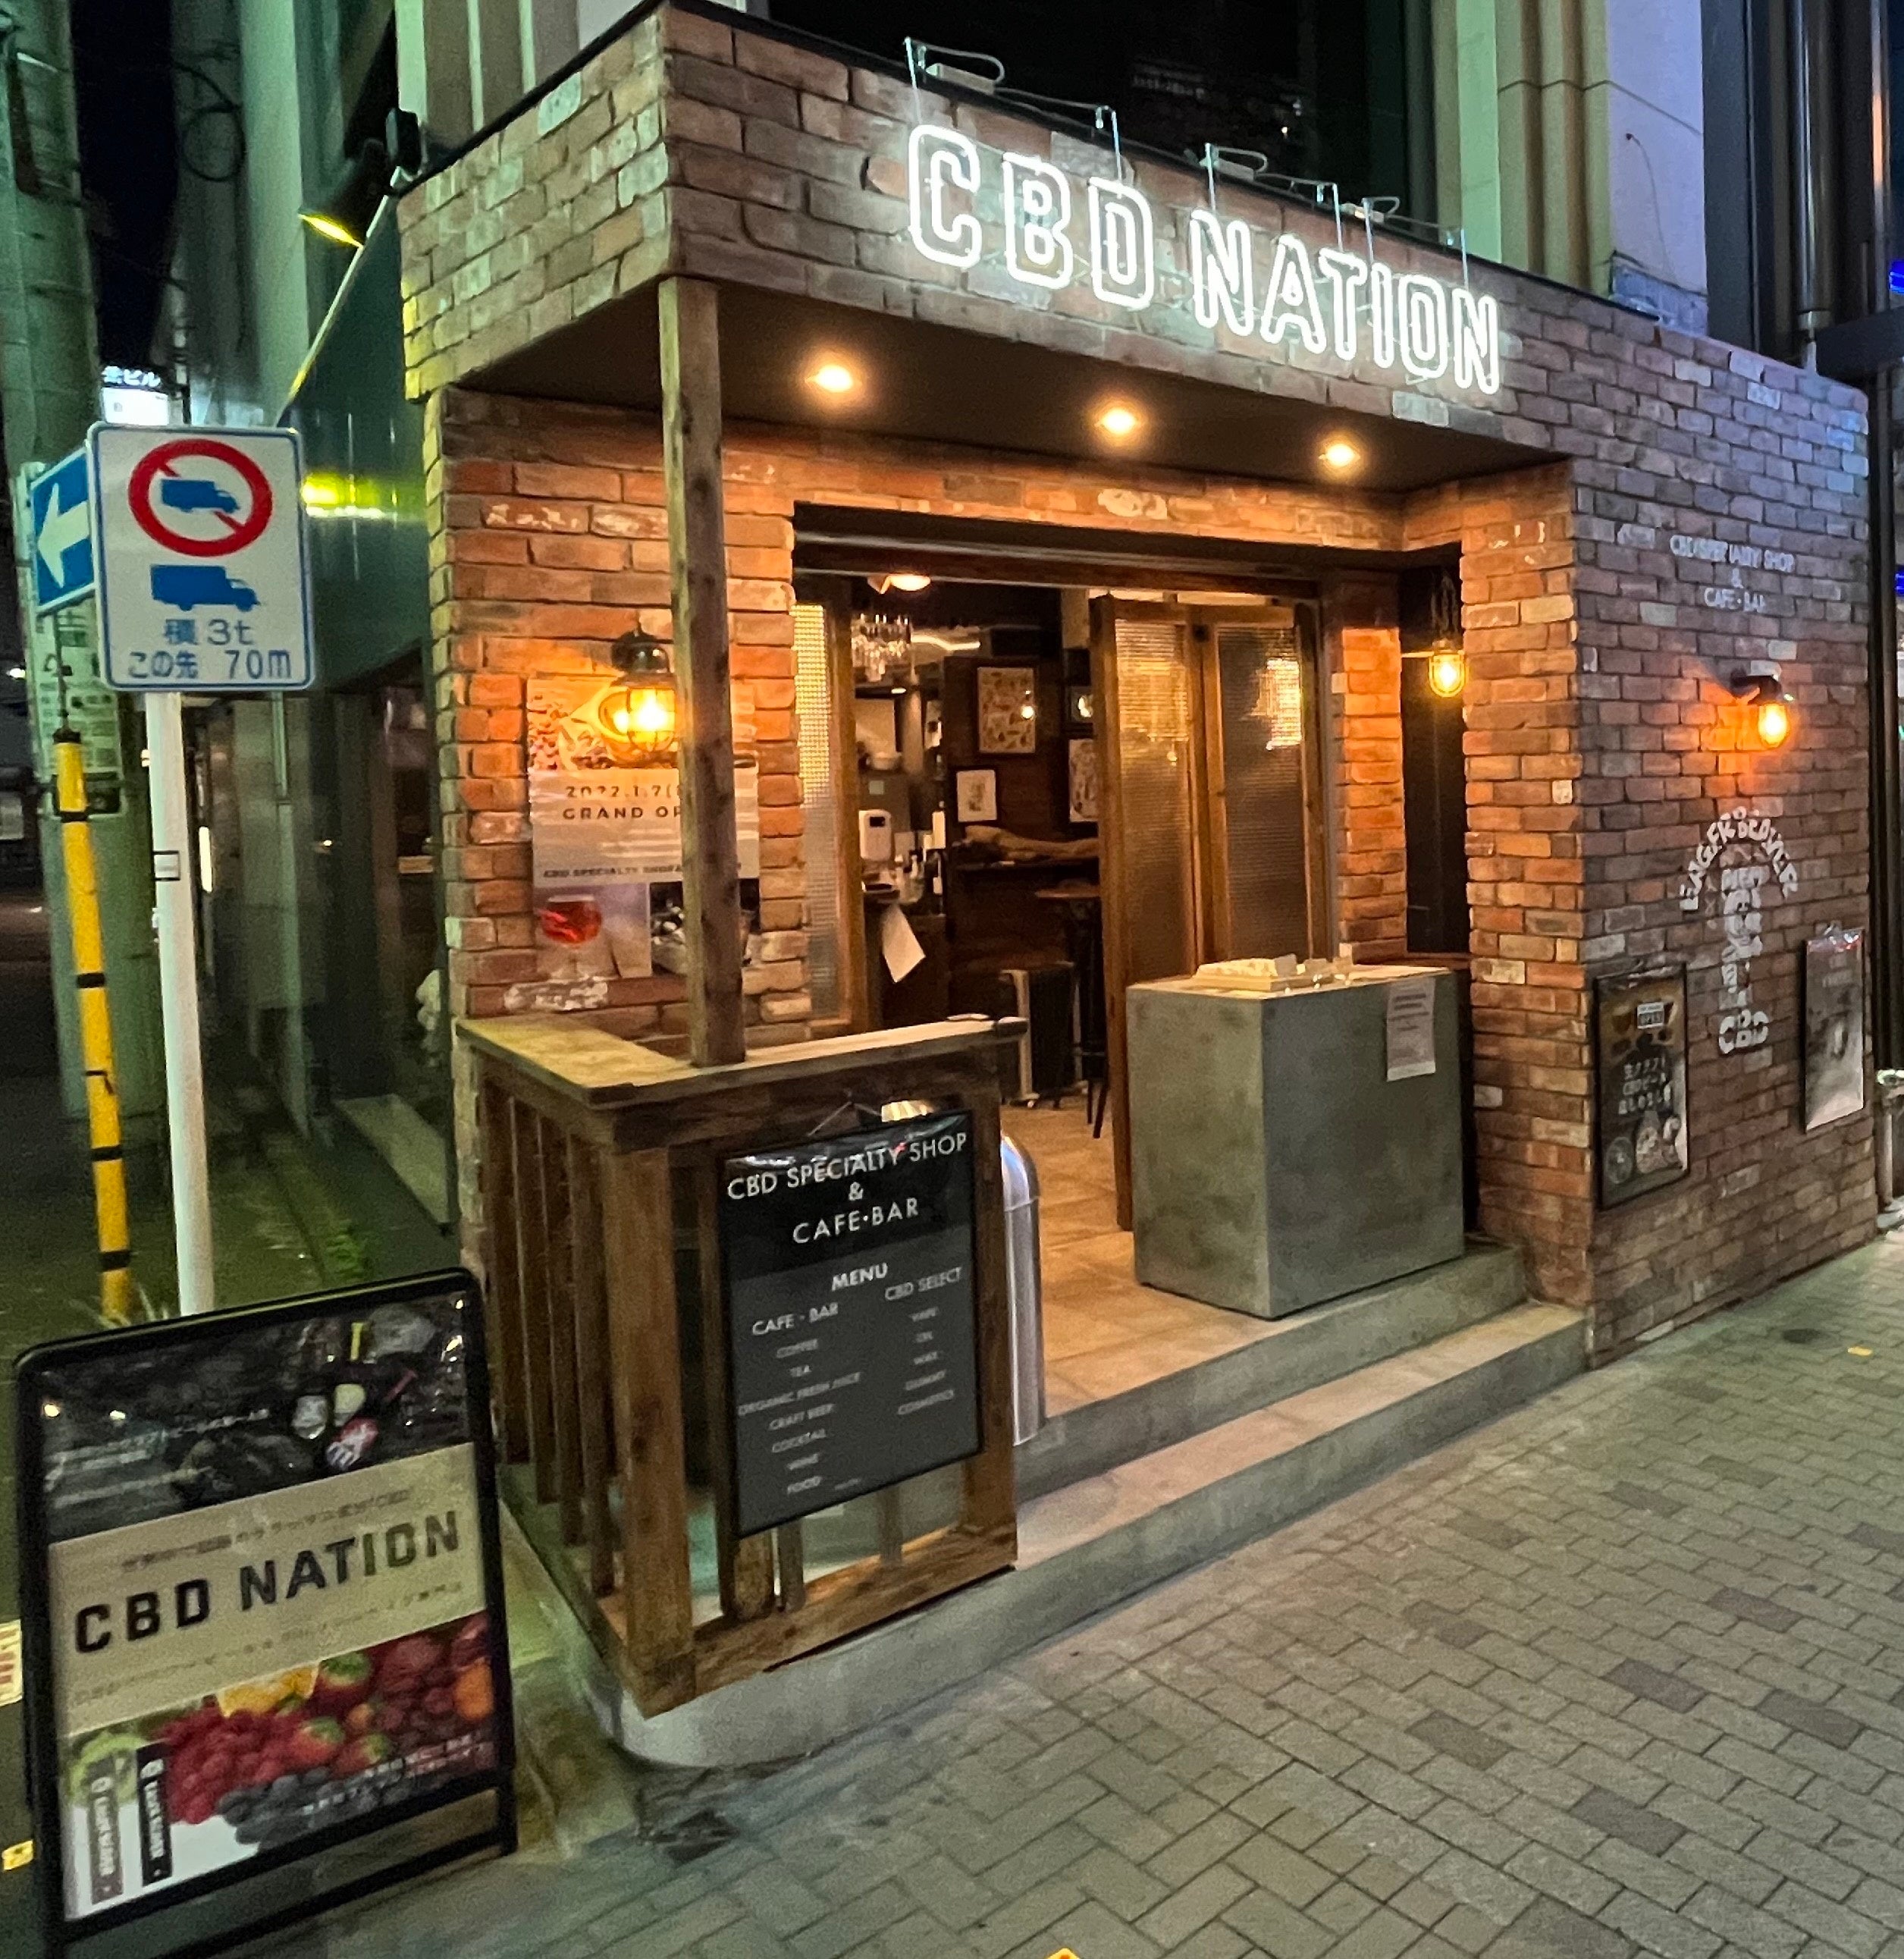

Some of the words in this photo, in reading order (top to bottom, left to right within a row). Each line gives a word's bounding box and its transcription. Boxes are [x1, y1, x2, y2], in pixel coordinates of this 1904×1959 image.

[908, 124, 1154, 310] CBD
[1189, 209, 1500, 395] NATION
[128, 650, 199, 680] この先
[224, 649, 292, 680] 70m
[563, 806, 644, 821] GRAND
[726, 1172, 778, 1201] CBD
[786, 1143, 905, 1189] SPECIALTY
[908, 1132, 968, 1163] SHOP
[848, 1181, 864, 1201] &
[831, 1262, 889, 1292] MENU
[917, 1266, 962, 1292] SELECT
[751, 1314, 795, 1336] CAFE
[809, 1301, 839, 1323] BAR
[74, 1578, 211, 1653] CBD
[238, 1509, 459, 1612] NATION
